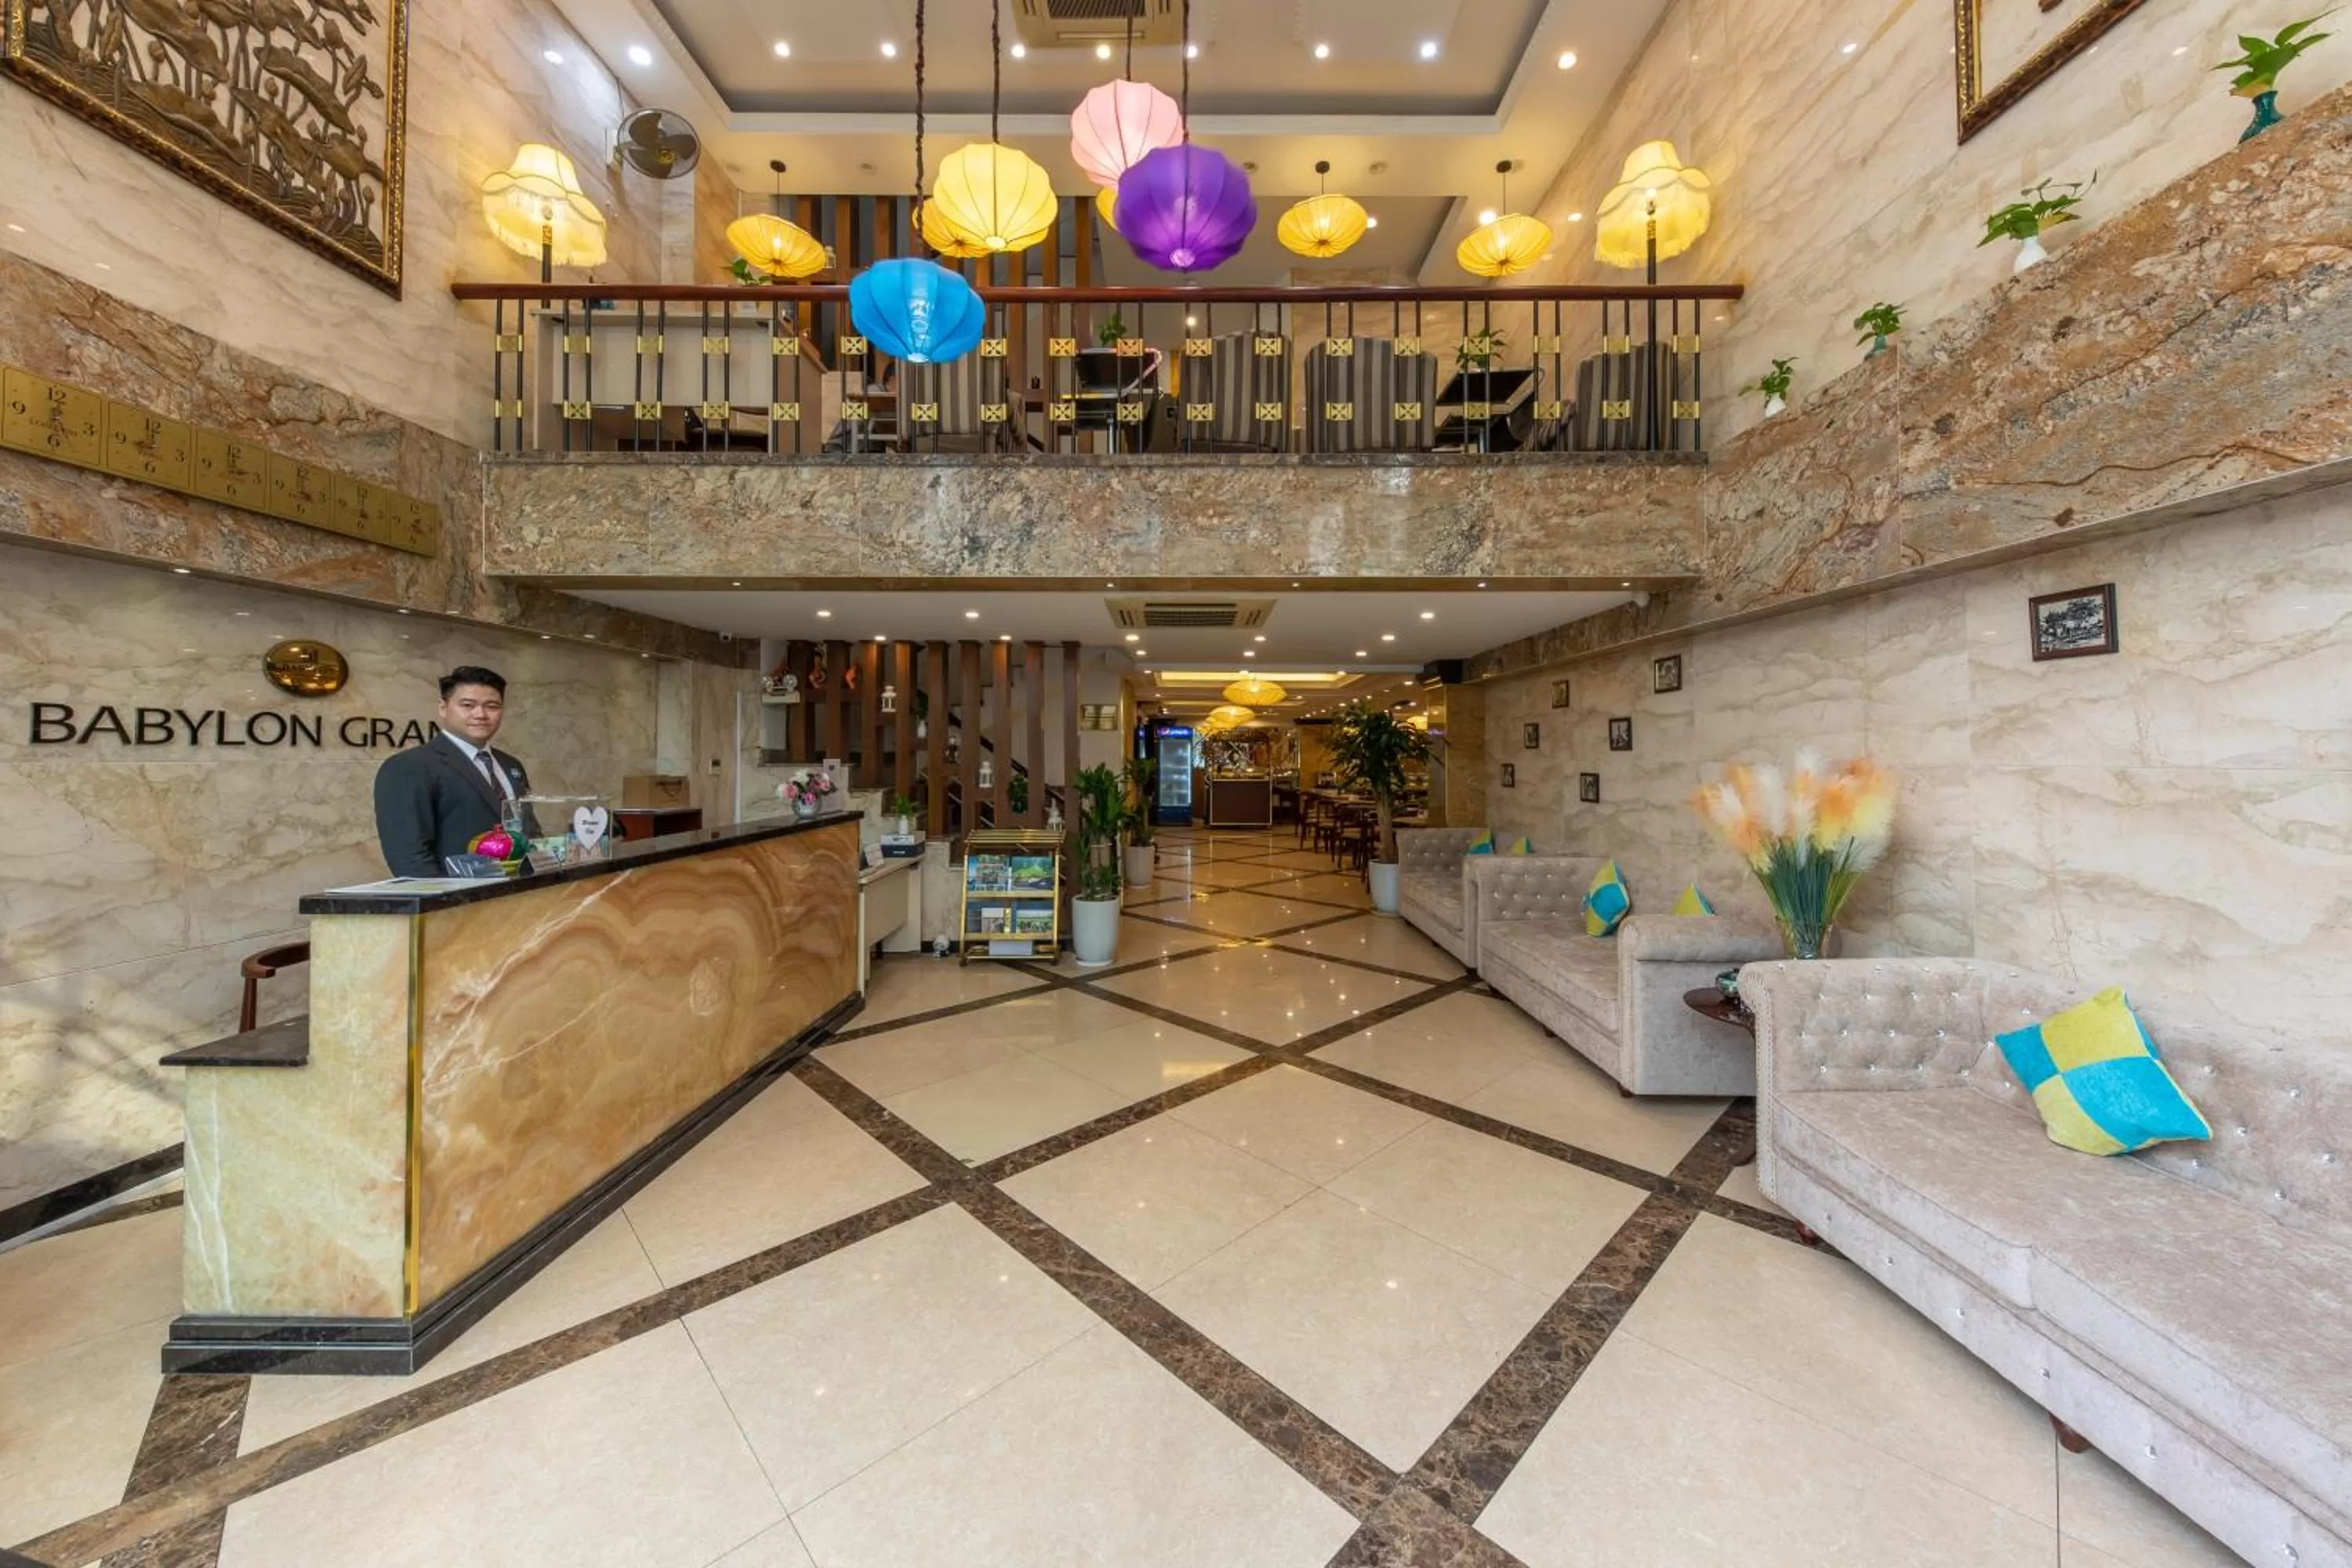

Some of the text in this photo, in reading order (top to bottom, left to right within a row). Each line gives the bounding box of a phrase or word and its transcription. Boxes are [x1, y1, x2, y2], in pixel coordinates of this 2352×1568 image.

[48, 386, 67, 405] 12
[12, 400, 26, 415] 9
[83, 420, 95, 436] 3
[145, 417, 161, 434] 12
[48, 434, 60, 452] 6
[175, 448, 185, 464] 3
[145, 460, 156, 474] 6
[31, 702, 322, 747] BABYLON
